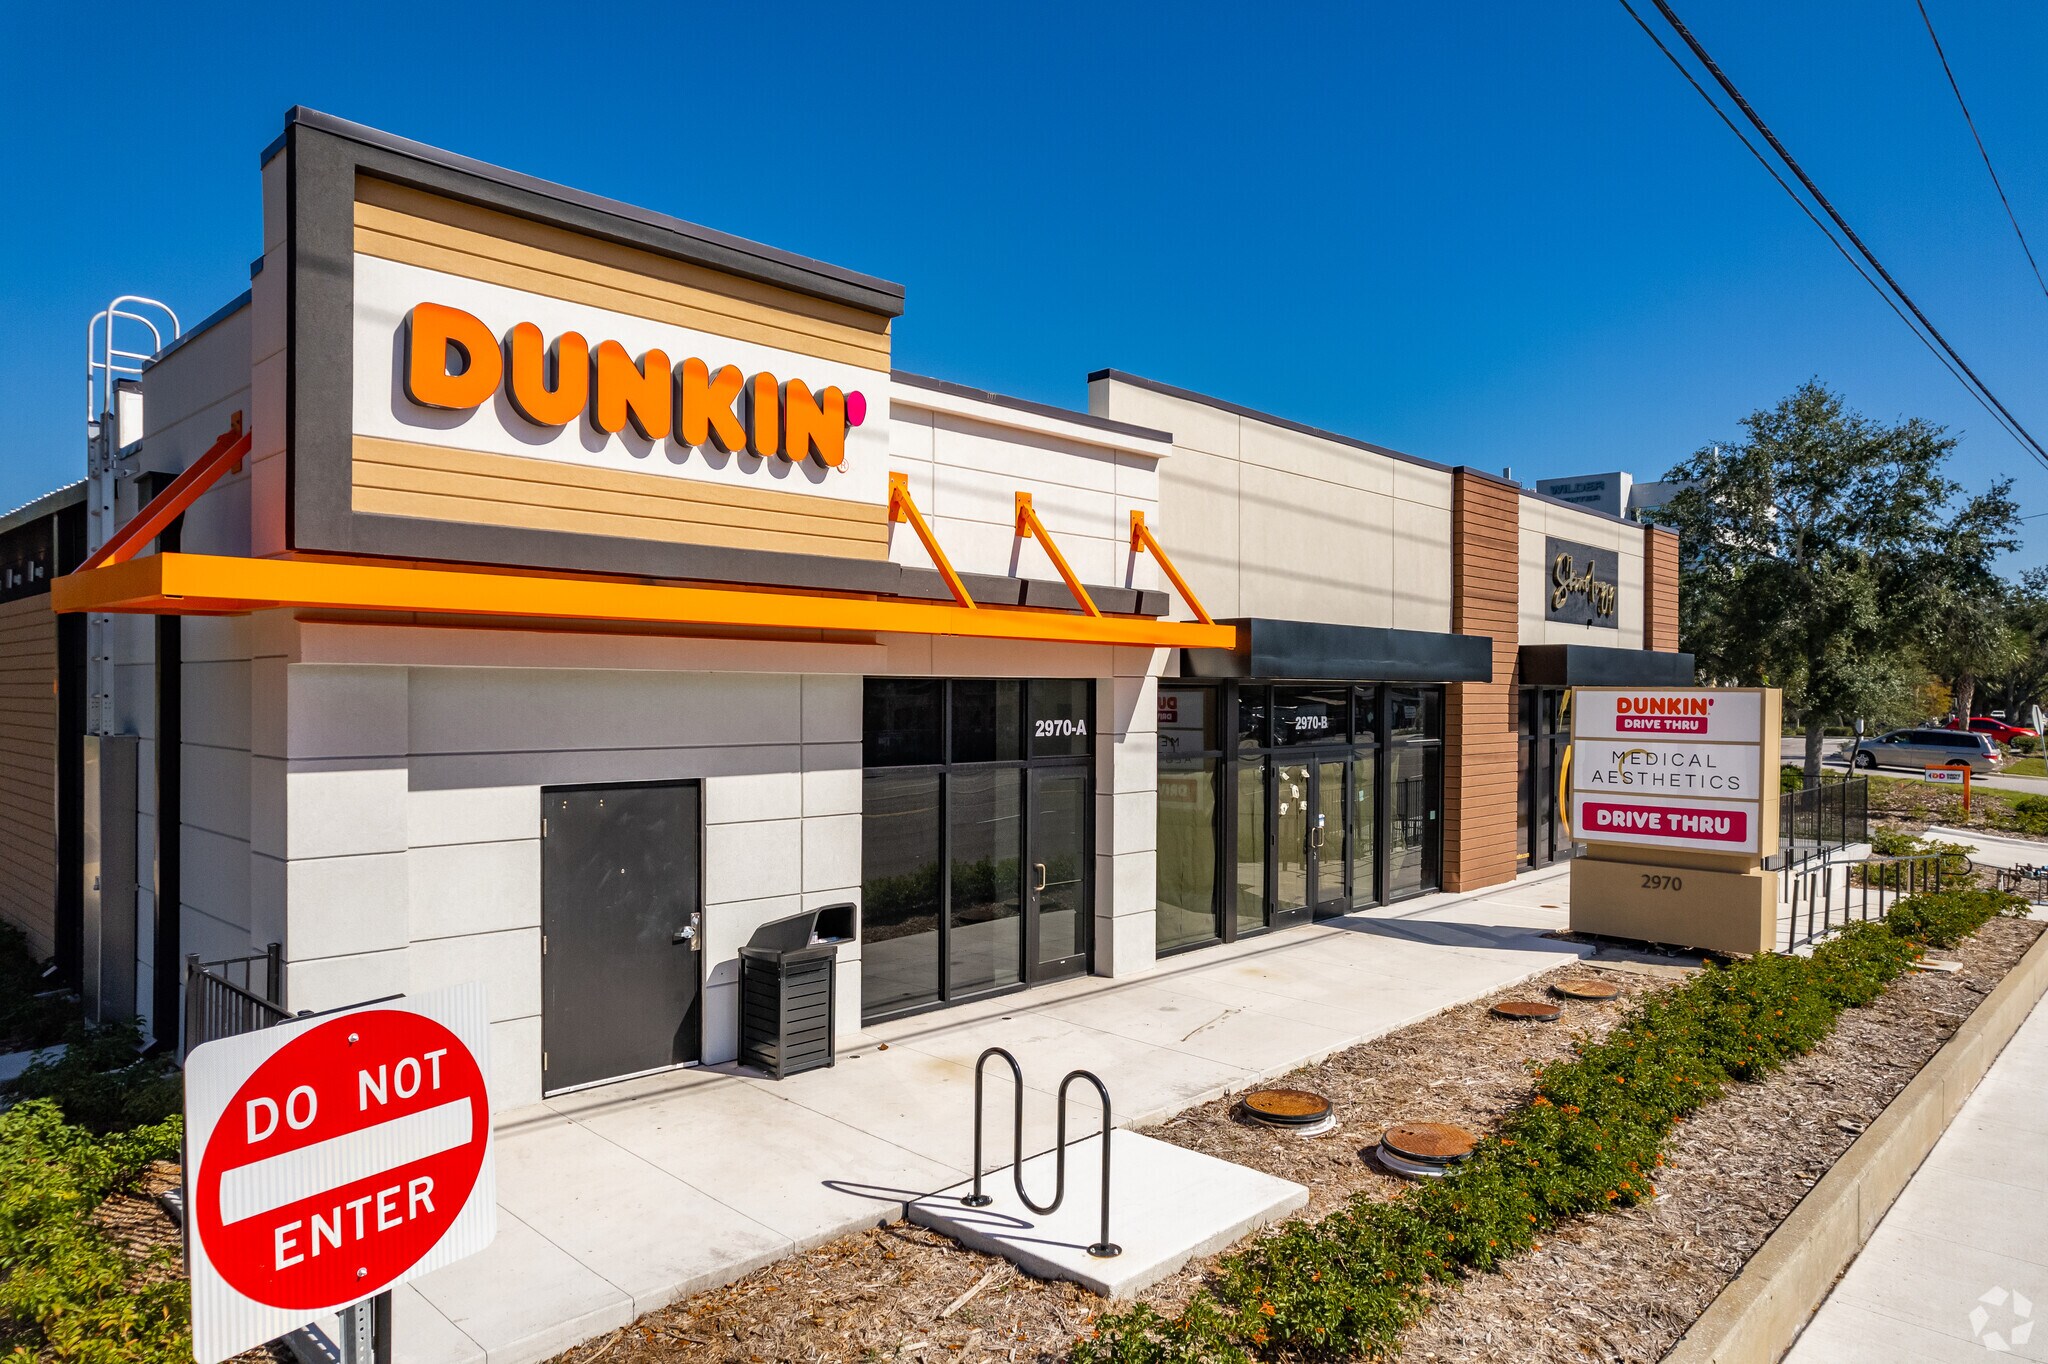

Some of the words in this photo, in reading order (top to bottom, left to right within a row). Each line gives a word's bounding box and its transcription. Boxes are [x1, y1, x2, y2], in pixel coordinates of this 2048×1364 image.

[403, 302, 866, 468] DUNKIN'
[1616, 697, 1714, 716] DUNKIN'
[1035, 719, 1087, 737] 2970-A
[1295, 716, 1328, 730] 2970-B
[1624, 719, 1661, 730] DRIVE
[1664, 720, 1699, 731] THRU
[1612, 751, 1717, 769] MEDICAL
[1591, 770, 1740, 791] AESTHETICS
[1597, 809, 1661, 830] DRIVE
[1667, 814, 1731, 835] THRU
[1641, 874, 1683, 891] 2970
[246, 1085, 318, 1145] DO
[358, 1048, 448, 1111] NOT
[273, 1175, 436, 1271] ENTER
